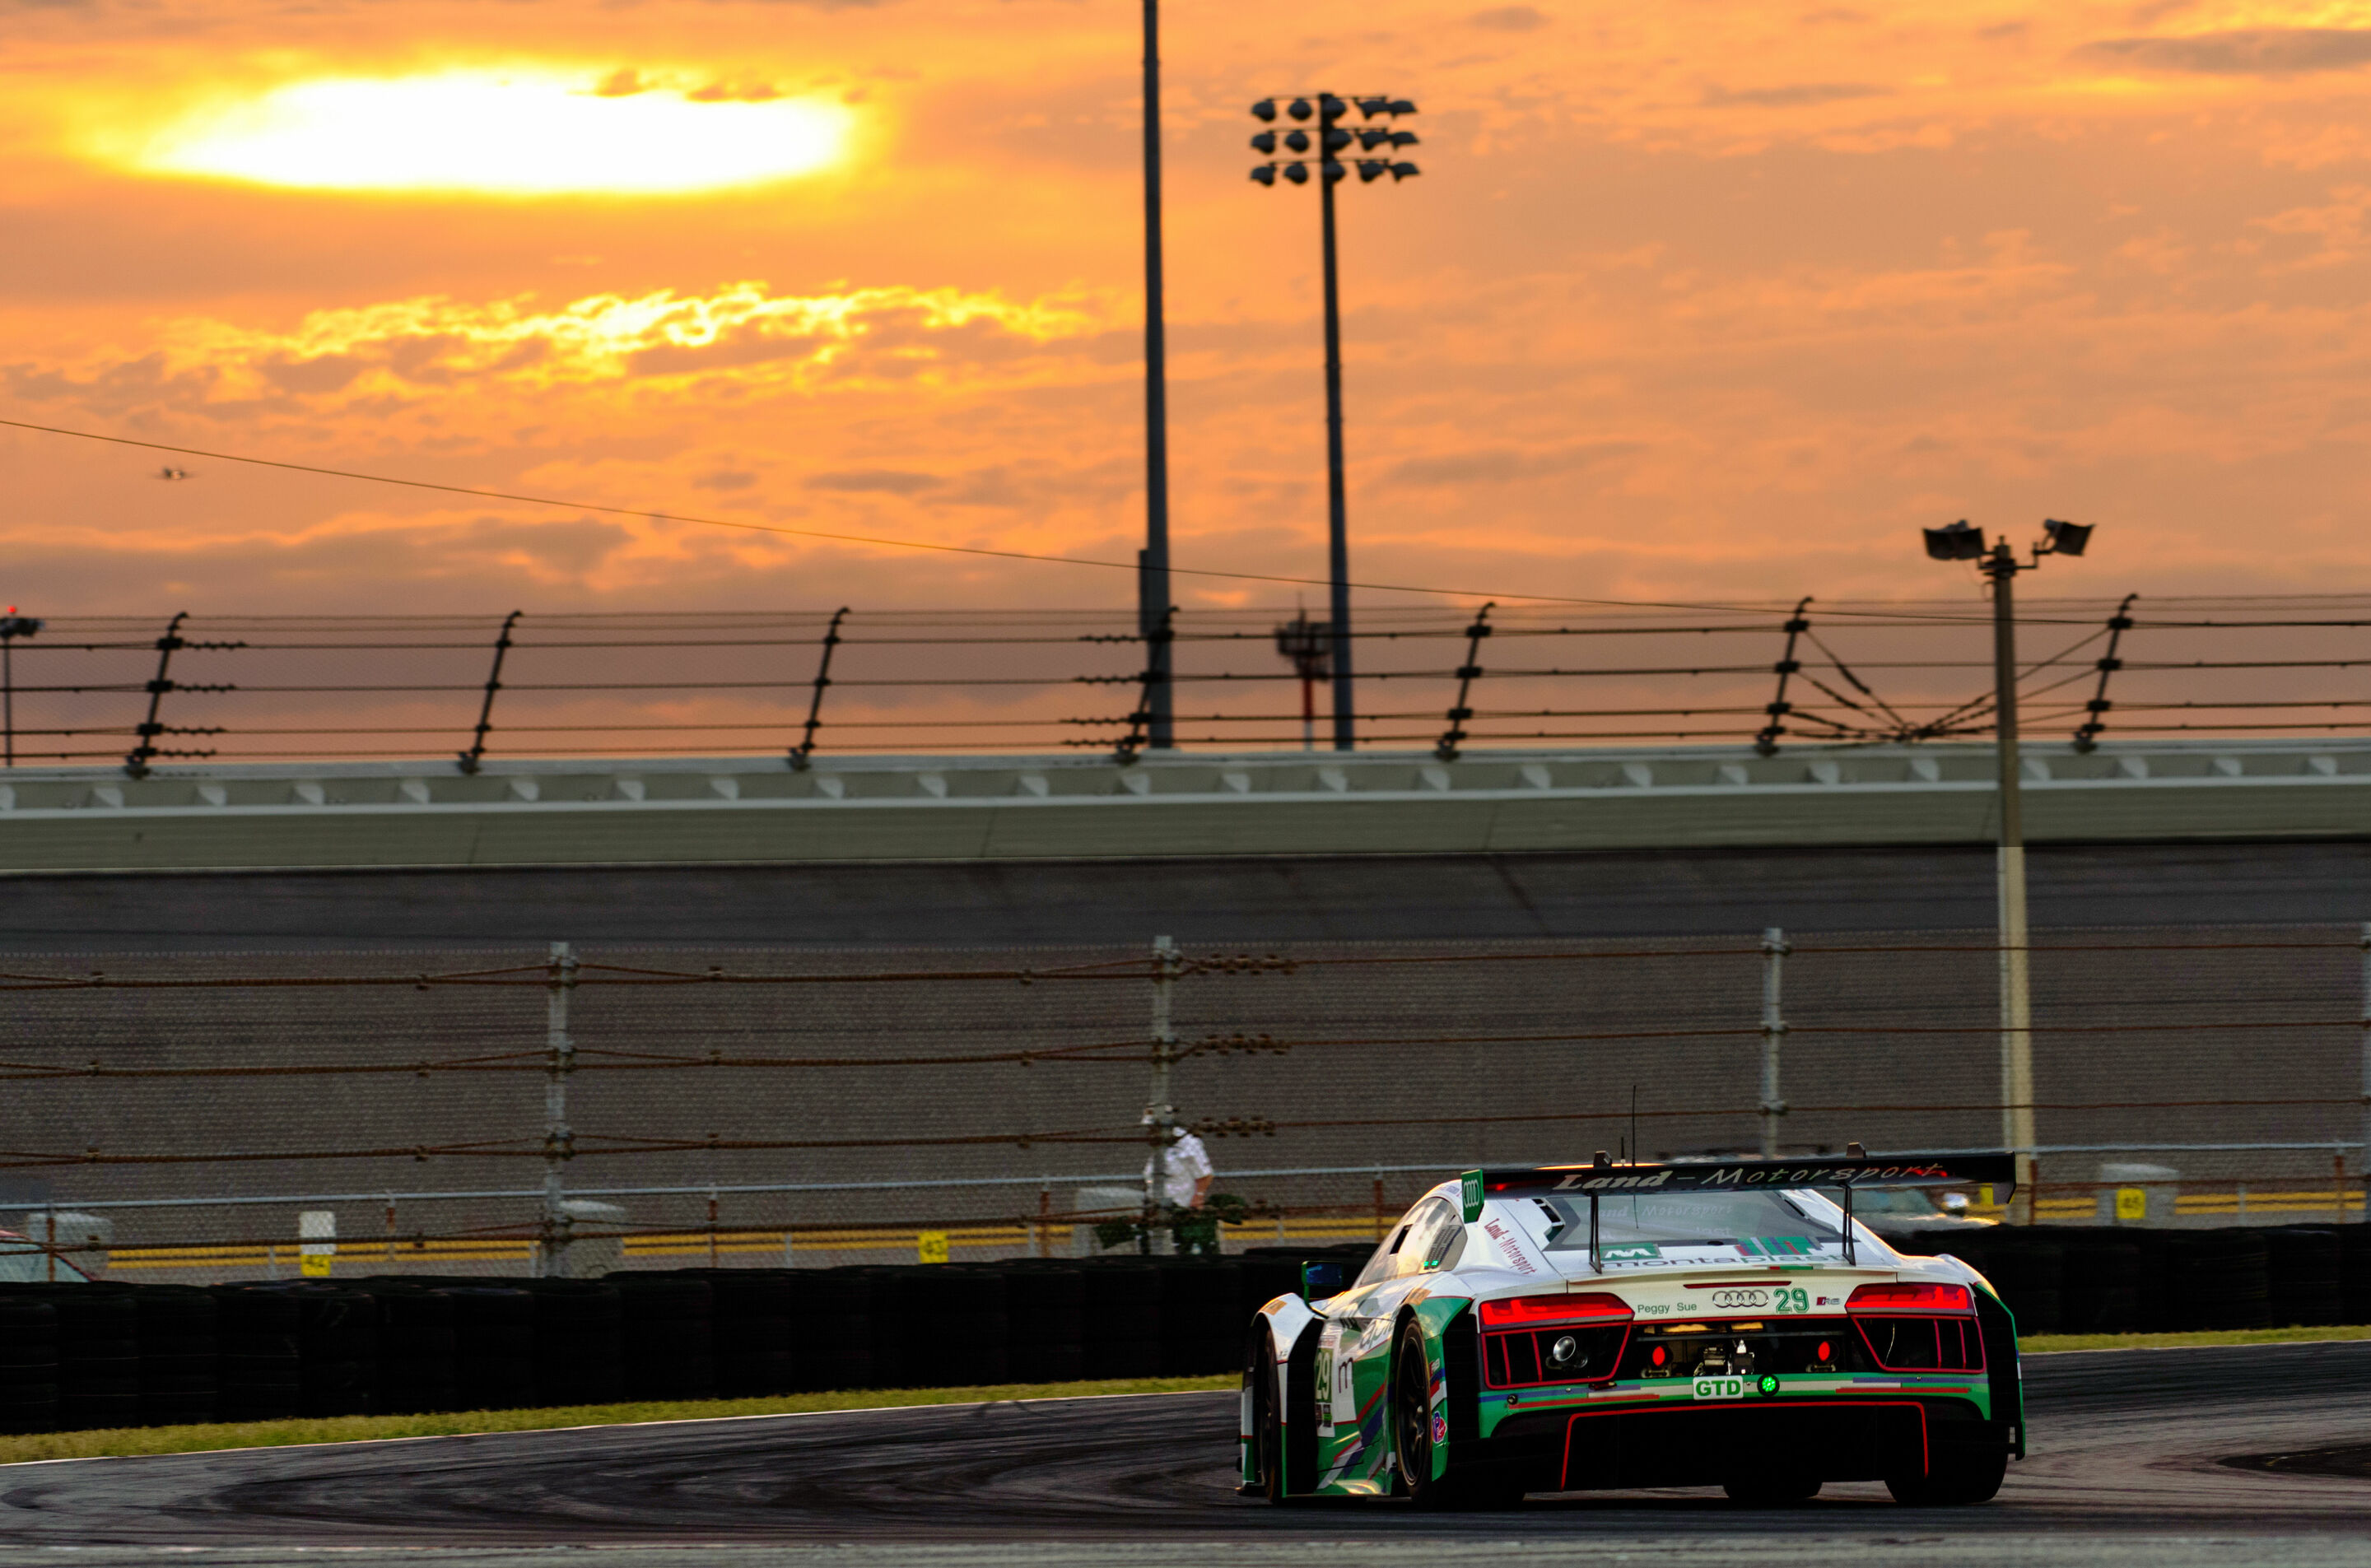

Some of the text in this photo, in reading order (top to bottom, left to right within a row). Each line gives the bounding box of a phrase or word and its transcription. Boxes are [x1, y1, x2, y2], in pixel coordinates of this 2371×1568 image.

[1637, 1302, 1698, 1314] Peggy Sue
[1773, 1288, 1810, 1314] 29
[1316, 1352, 1330, 1400] 29
[1696, 1380, 1741, 1396] GTD
